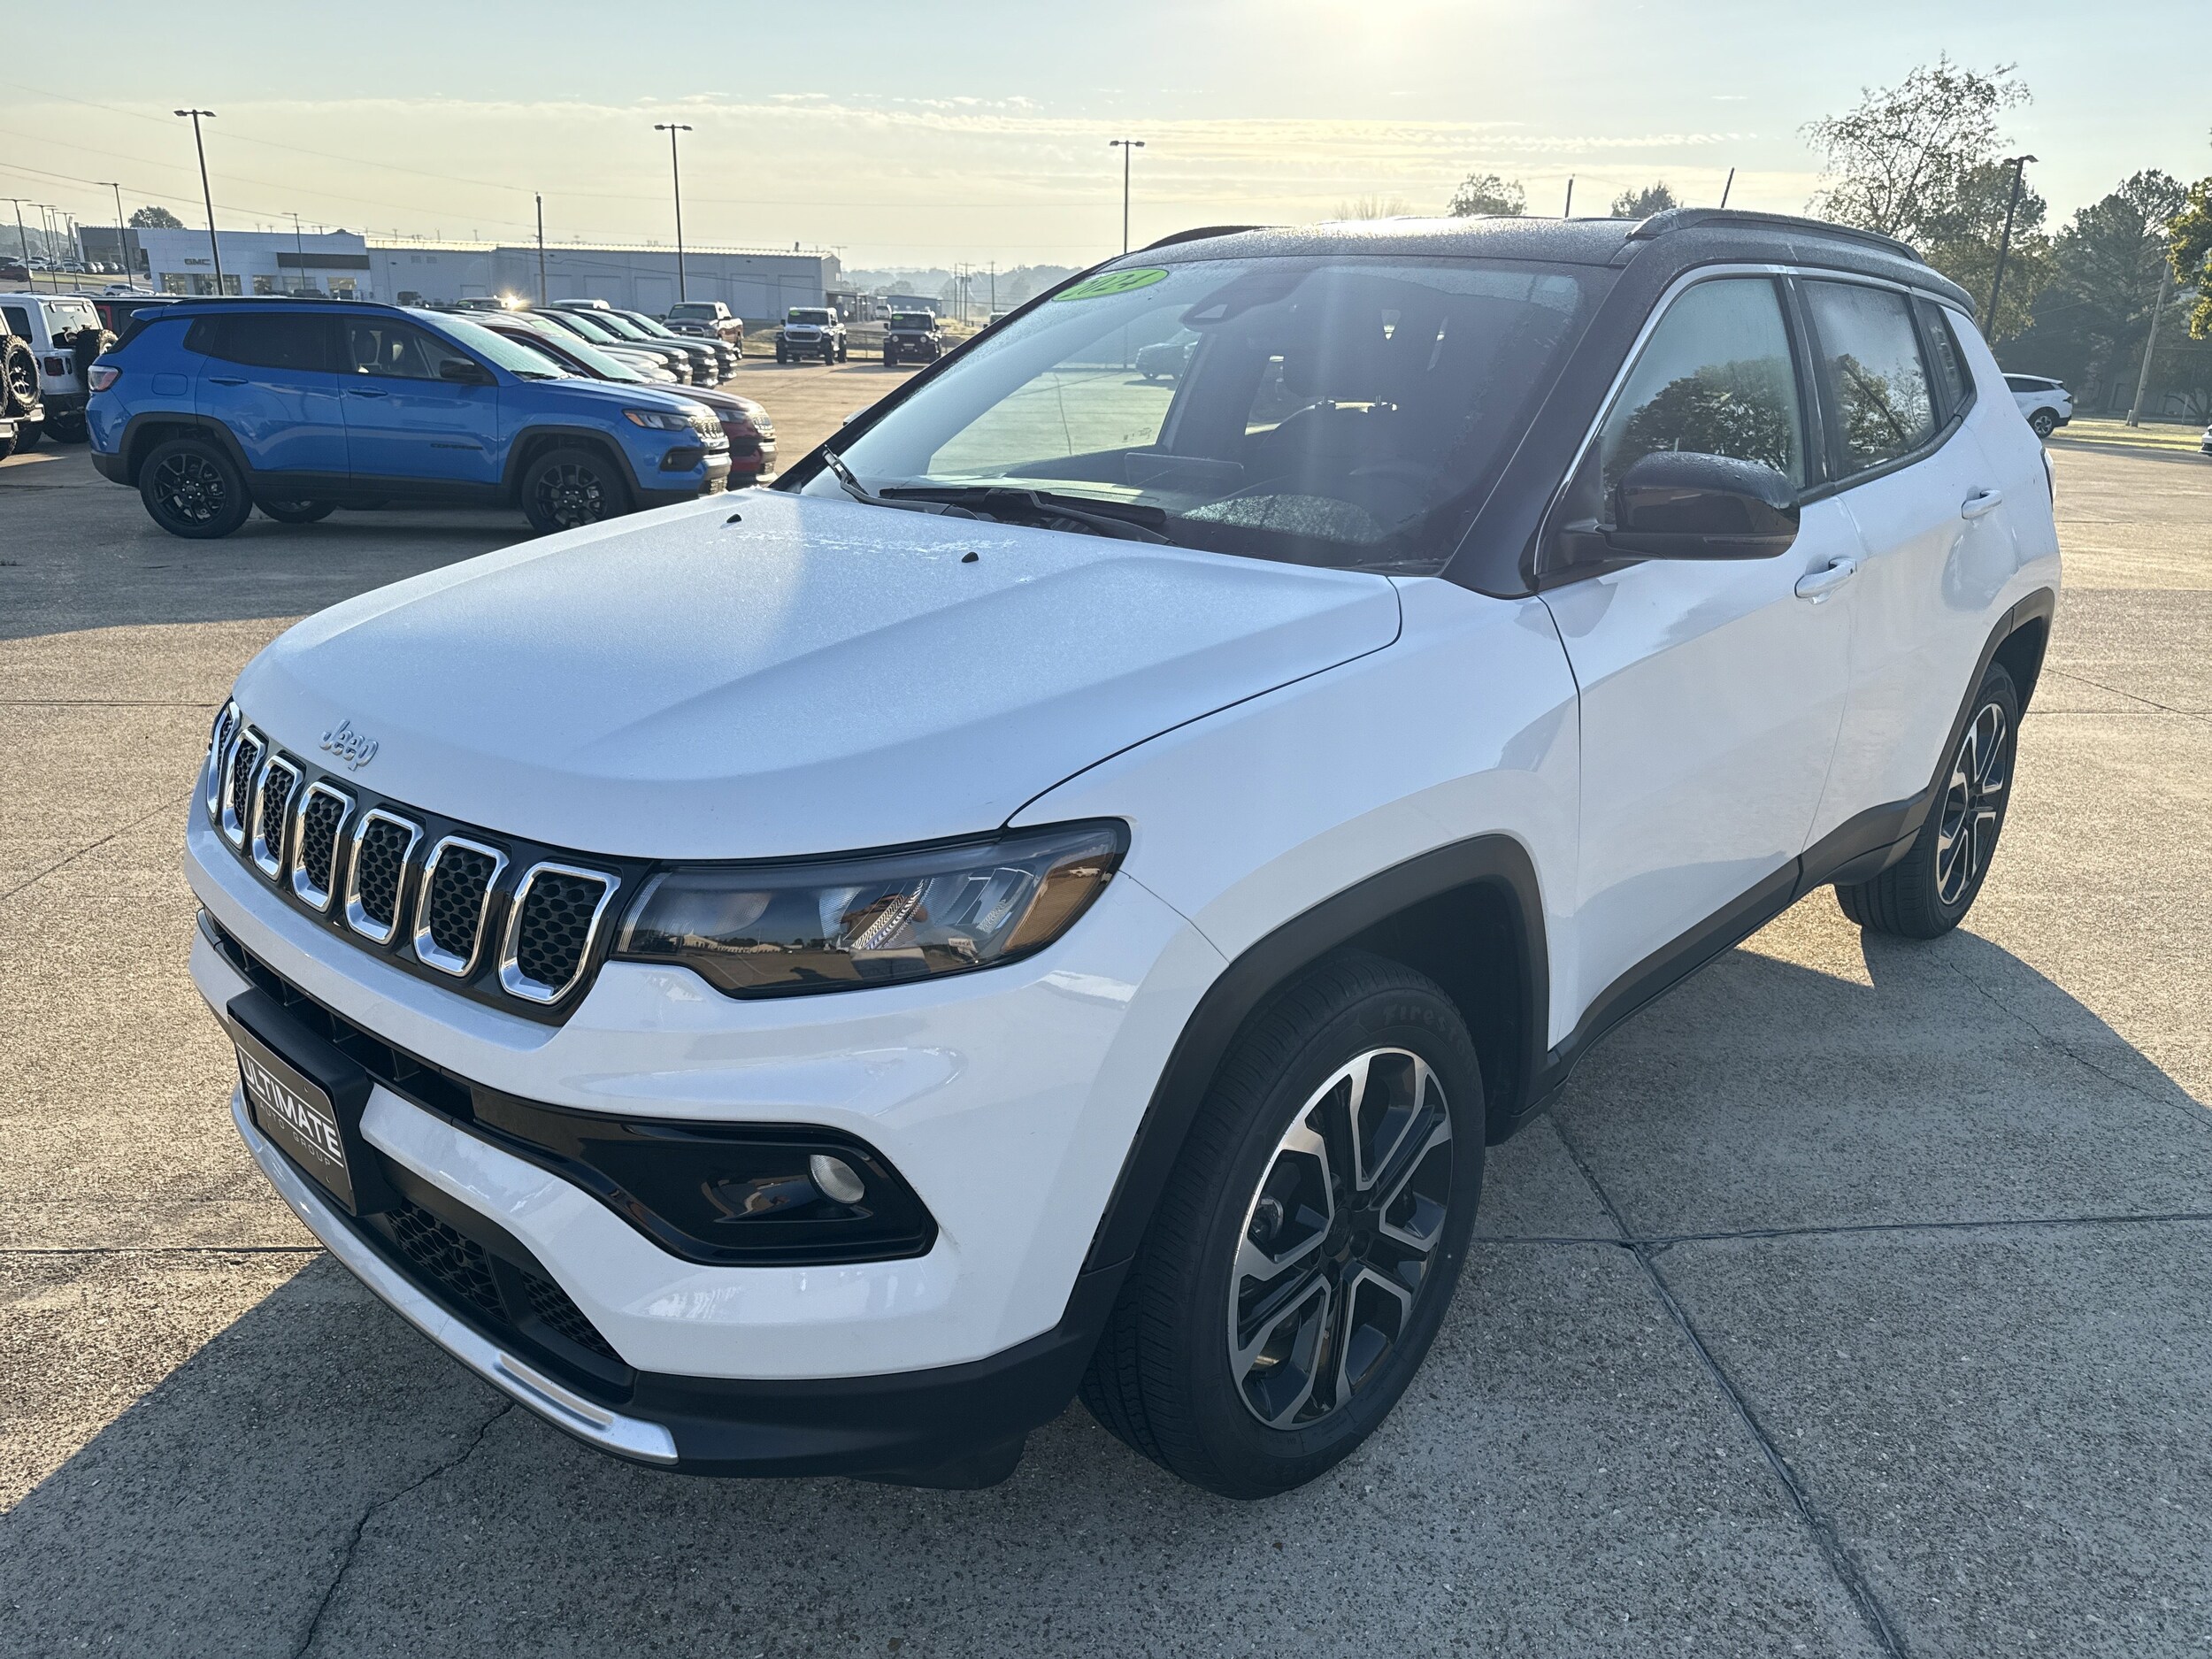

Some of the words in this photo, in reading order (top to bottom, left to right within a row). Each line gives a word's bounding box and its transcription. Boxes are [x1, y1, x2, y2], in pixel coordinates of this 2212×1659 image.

[1058, 271, 1161, 300] 2024
[319, 719, 379, 772] Jeep
[238, 1050, 342, 1158] ULTIMATE
[259, 1101, 286, 1130] AUTO
[292, 1132, 332, 1167] GROUP
